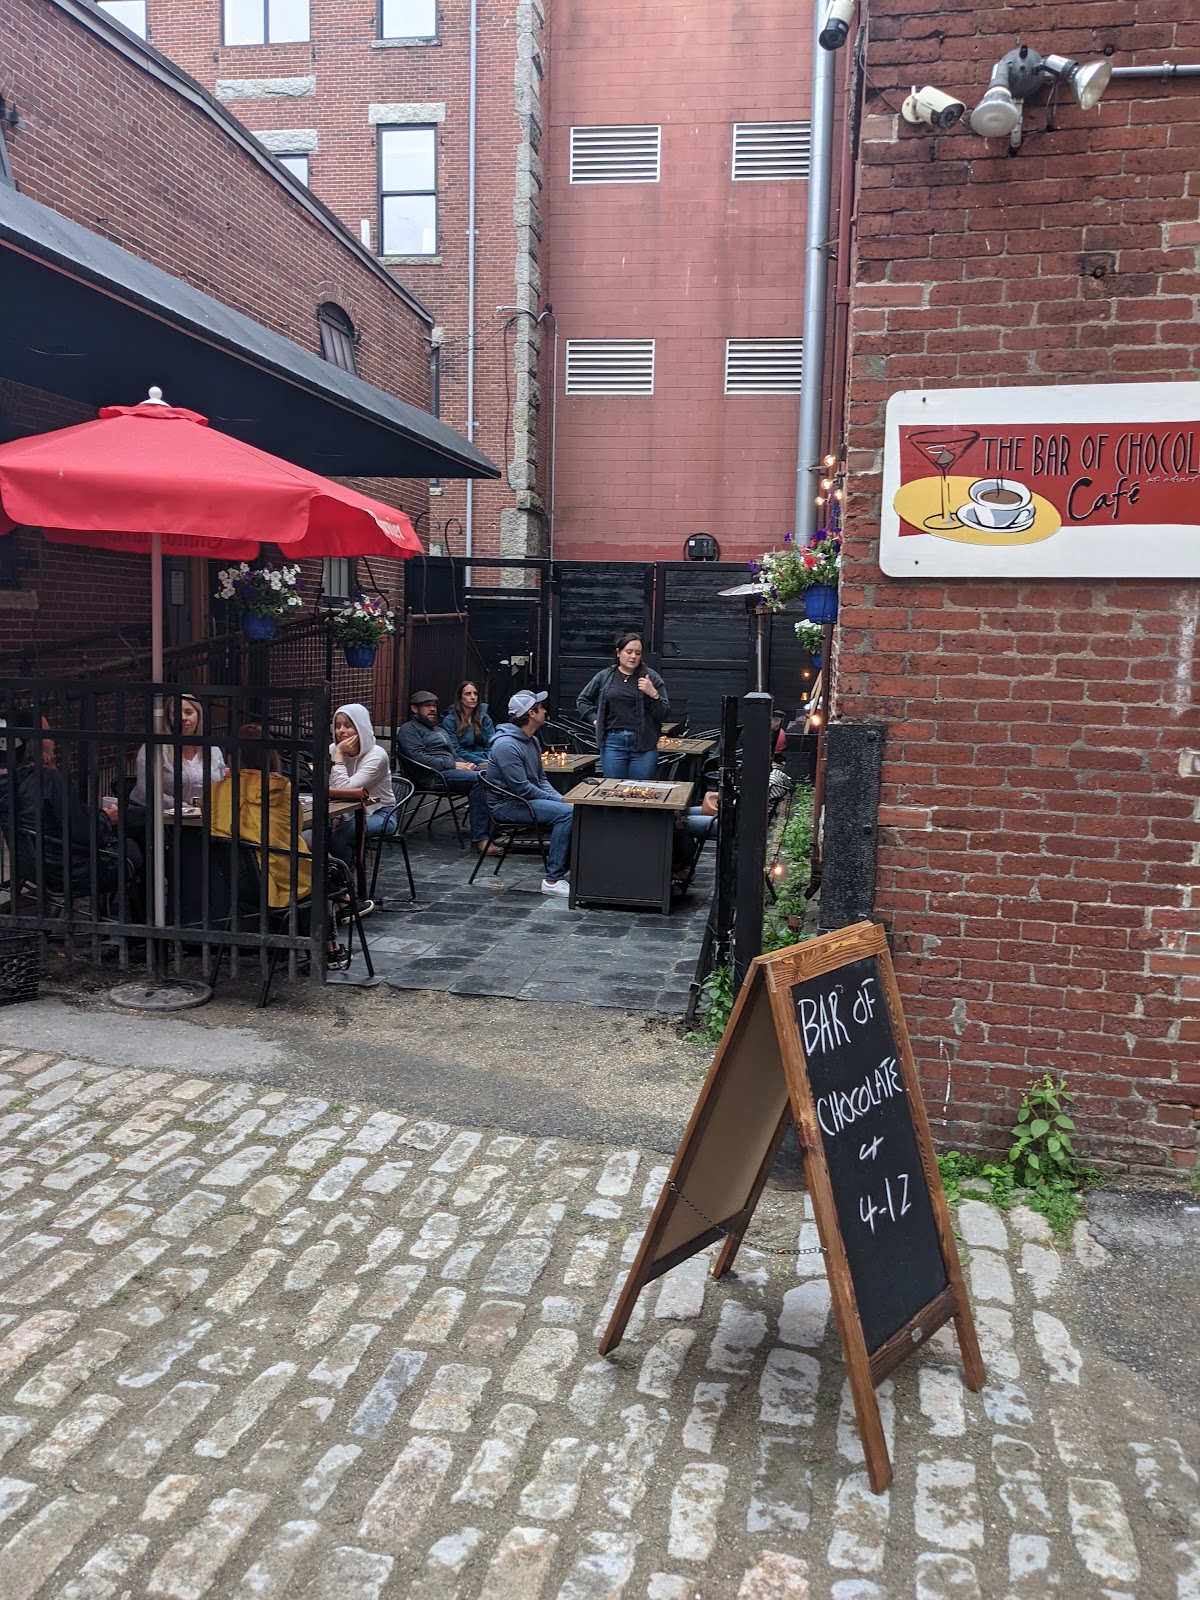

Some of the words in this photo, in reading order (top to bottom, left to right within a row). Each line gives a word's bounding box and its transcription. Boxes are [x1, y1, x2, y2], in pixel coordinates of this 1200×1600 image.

[980, 436, 1026, 471] THE
[1031, 434, 1068, 476] BAR
[1080, 433, 1110, 471] OF
[1114, 431, 1200, 475] CHOCOL
[1067, 476, 1140, 521] Café
[797, 991, 851, 1057] BAR
[852, 978, 876, 1024] OF
[816, 1056, 903, 1136] CHOCOLATE
[859, 1173, 912, 1235] 4-12
